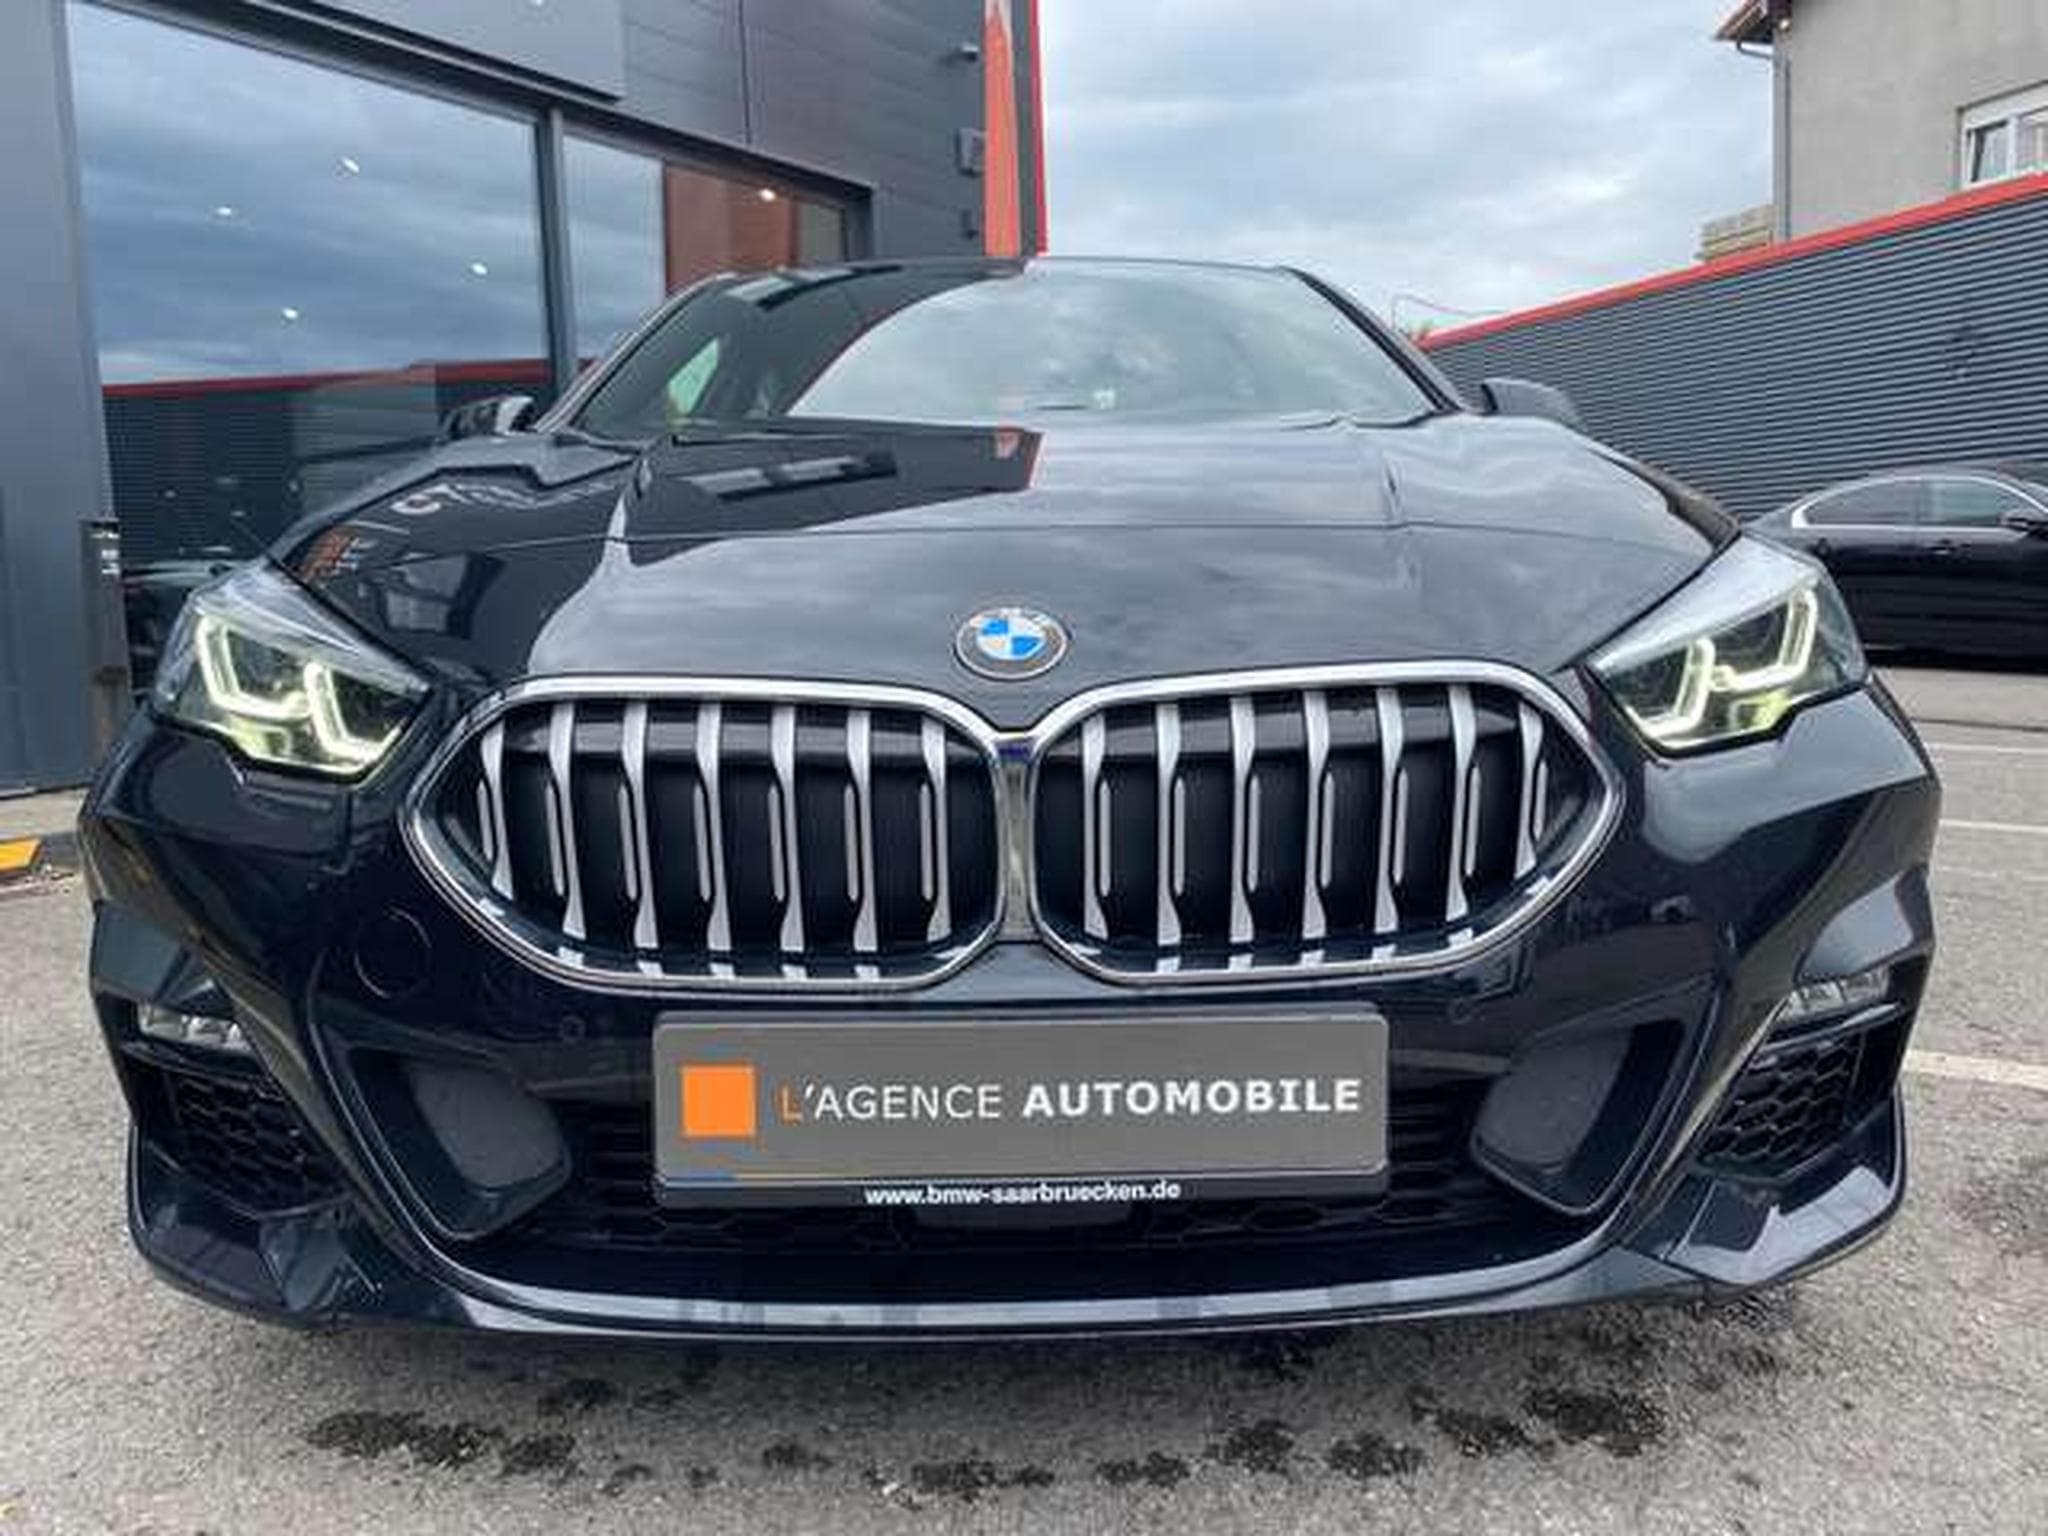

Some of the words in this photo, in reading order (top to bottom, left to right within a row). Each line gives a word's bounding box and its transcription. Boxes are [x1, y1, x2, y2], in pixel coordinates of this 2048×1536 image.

[779, 1082, 1002, 1122] L'AGENCE
[1021, 1078, 1362, 1118] AUTOMOBILE
[863, 1180, 1182, 1205] www.bmw-saarbruecken.de
